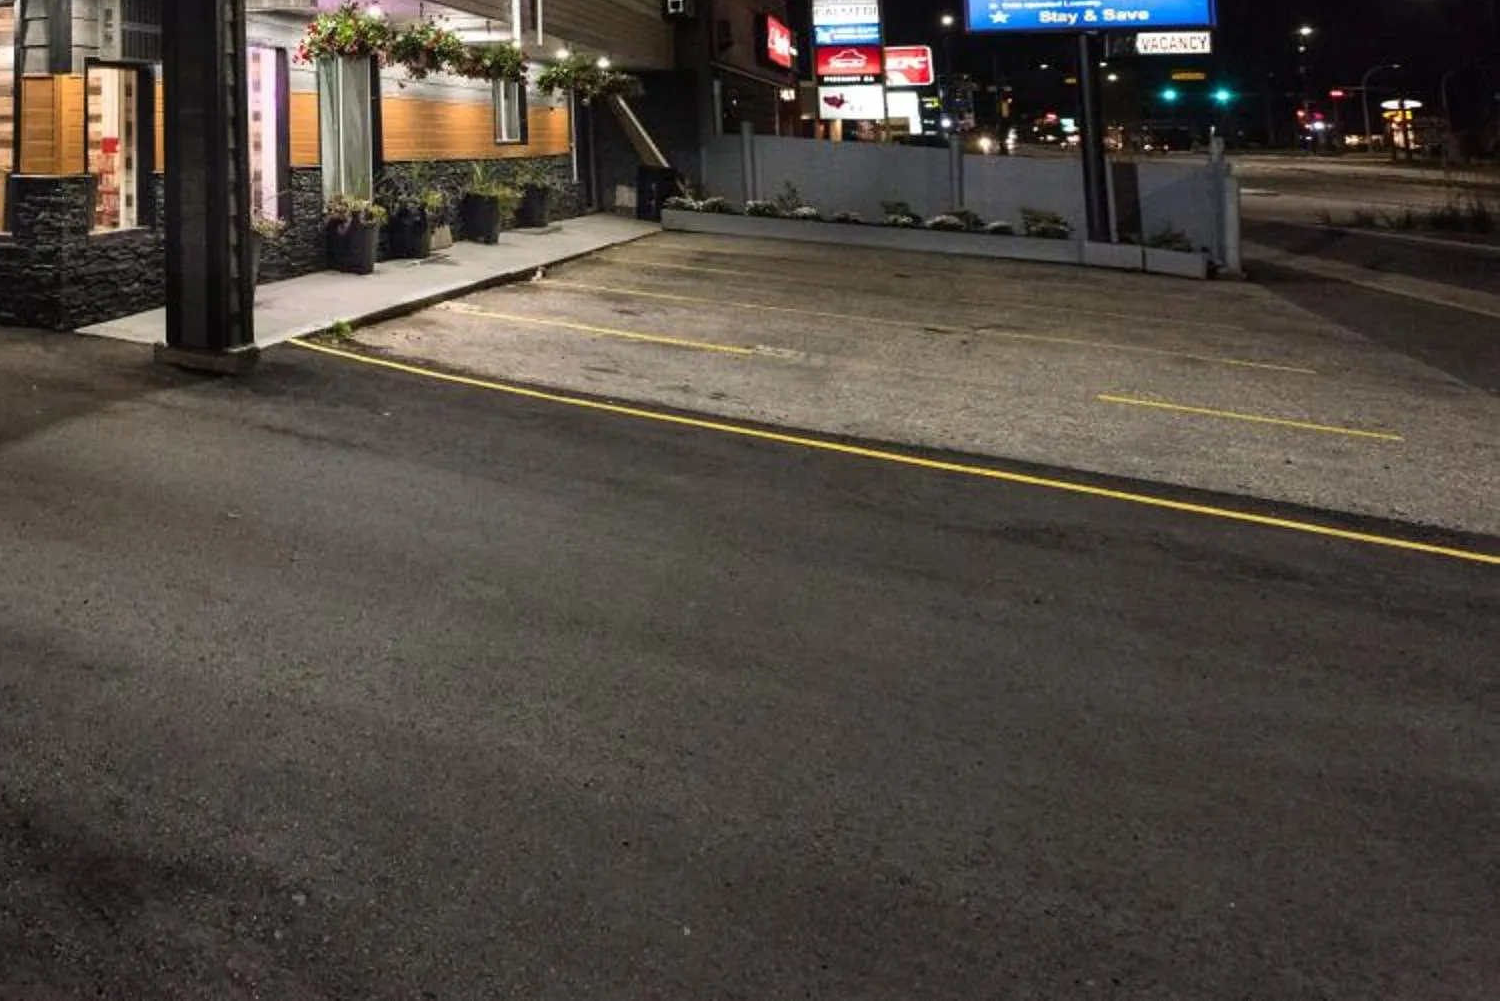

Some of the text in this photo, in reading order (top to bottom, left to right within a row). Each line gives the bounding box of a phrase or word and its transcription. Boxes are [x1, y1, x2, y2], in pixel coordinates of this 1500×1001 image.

[1039, 8, 1150, 25] Stay & Save
[1141, 35, 1207, 51] VACANCY
